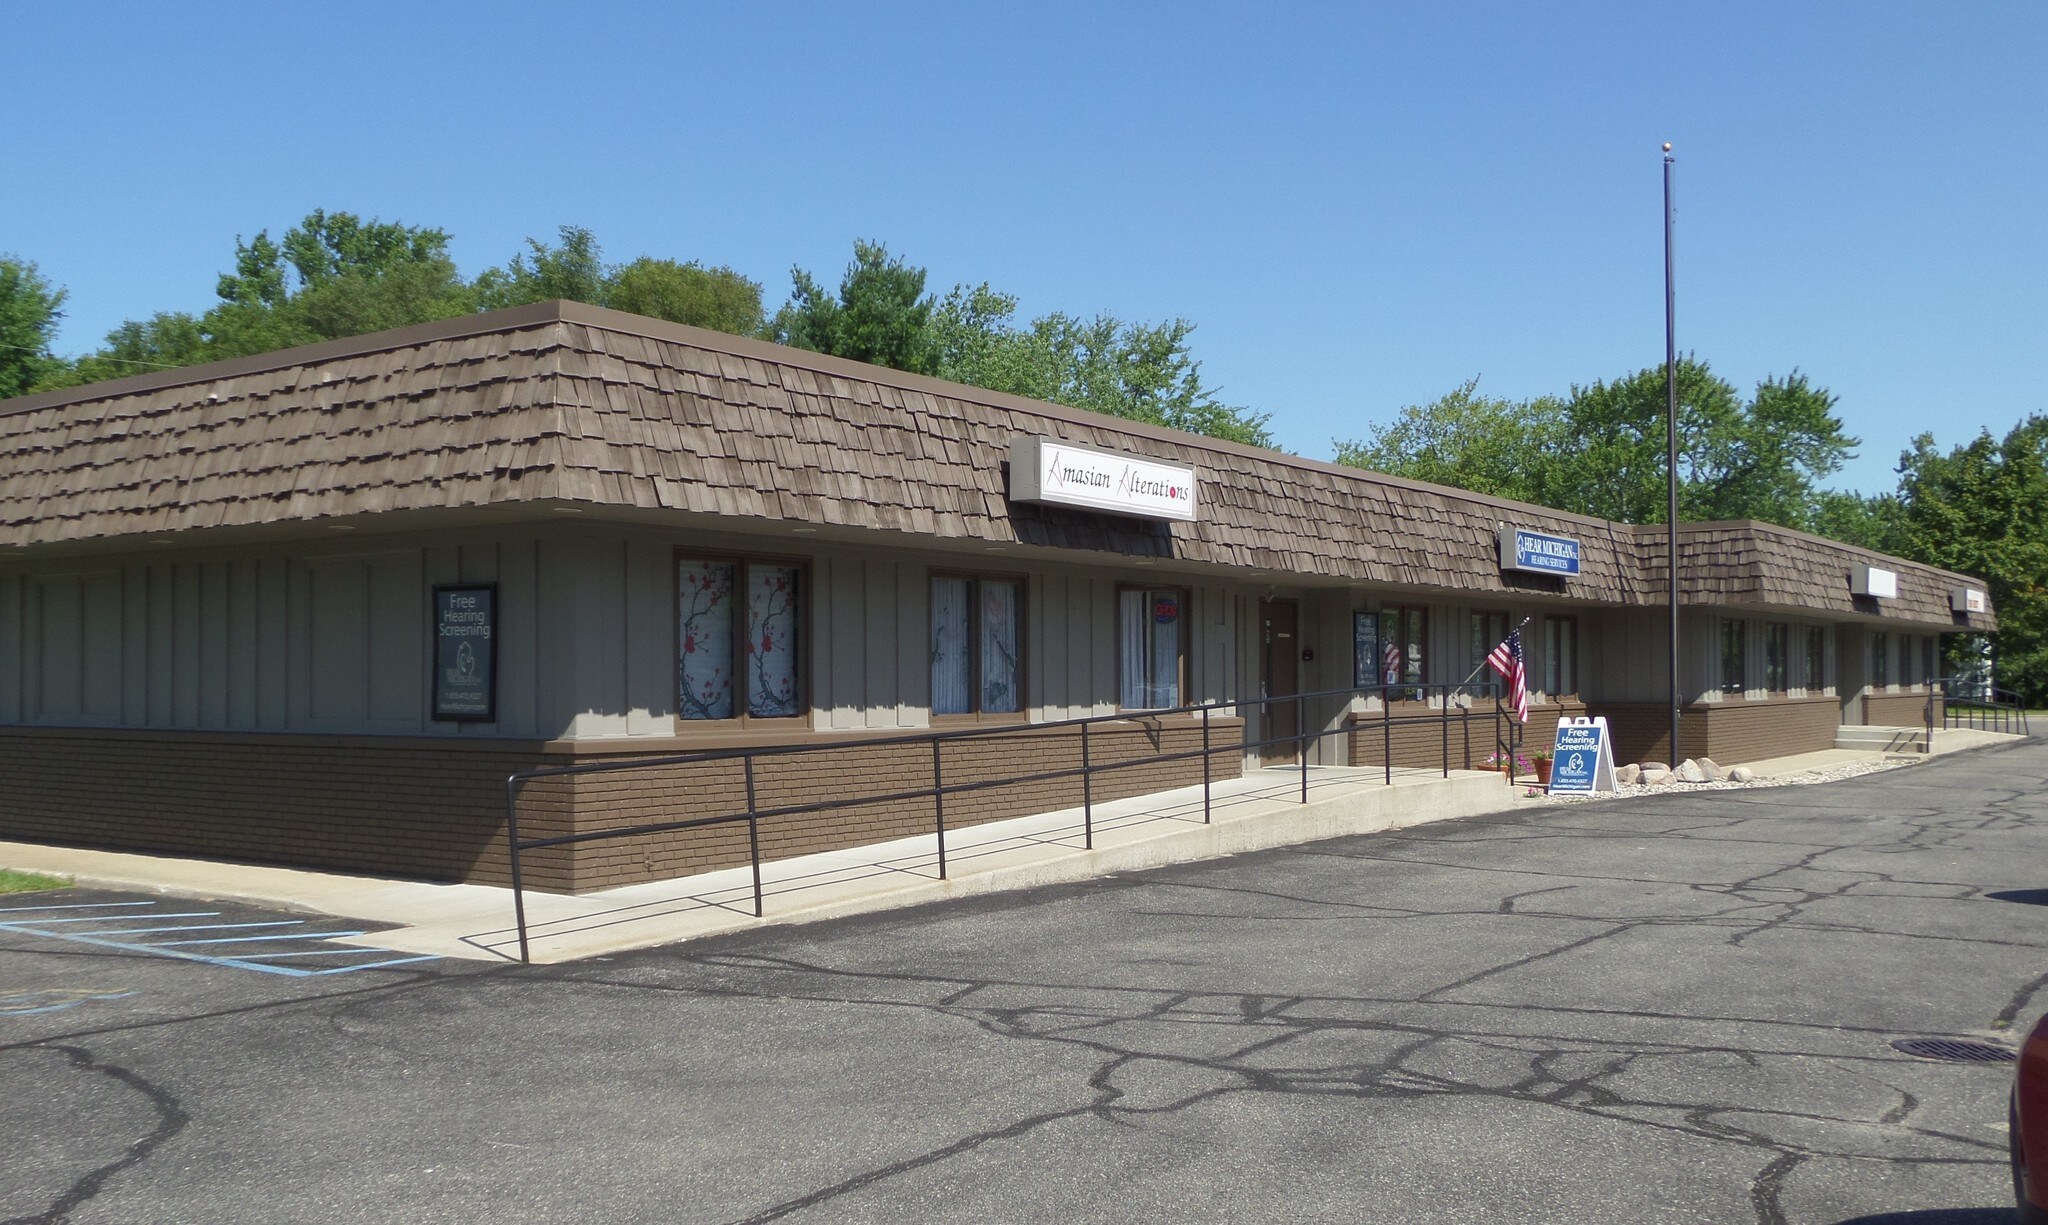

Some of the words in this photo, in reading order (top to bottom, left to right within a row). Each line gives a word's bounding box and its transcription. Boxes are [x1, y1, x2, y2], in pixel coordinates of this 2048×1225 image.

[1046, 451, 1110, 488] Amasian
[1116, 464, 1188, 500] Alterations
[1524, 537, 1543, 554] HEAR
[1543, 540, 1573, 559] MICHIGAN
[1531, 555, 1550, 566] HEARING
[1550, 557, 1568, 569] SERVICES
[450, 593, 476, 609] Free
[444, 609, 485, 625] Hearing
[439, 623, 490, 639] Screening
[1561, 736, 1595, 745] Hearing
[1567, 728, 1589, 737] Free
[1556, 743, 1598, 753] Screening
